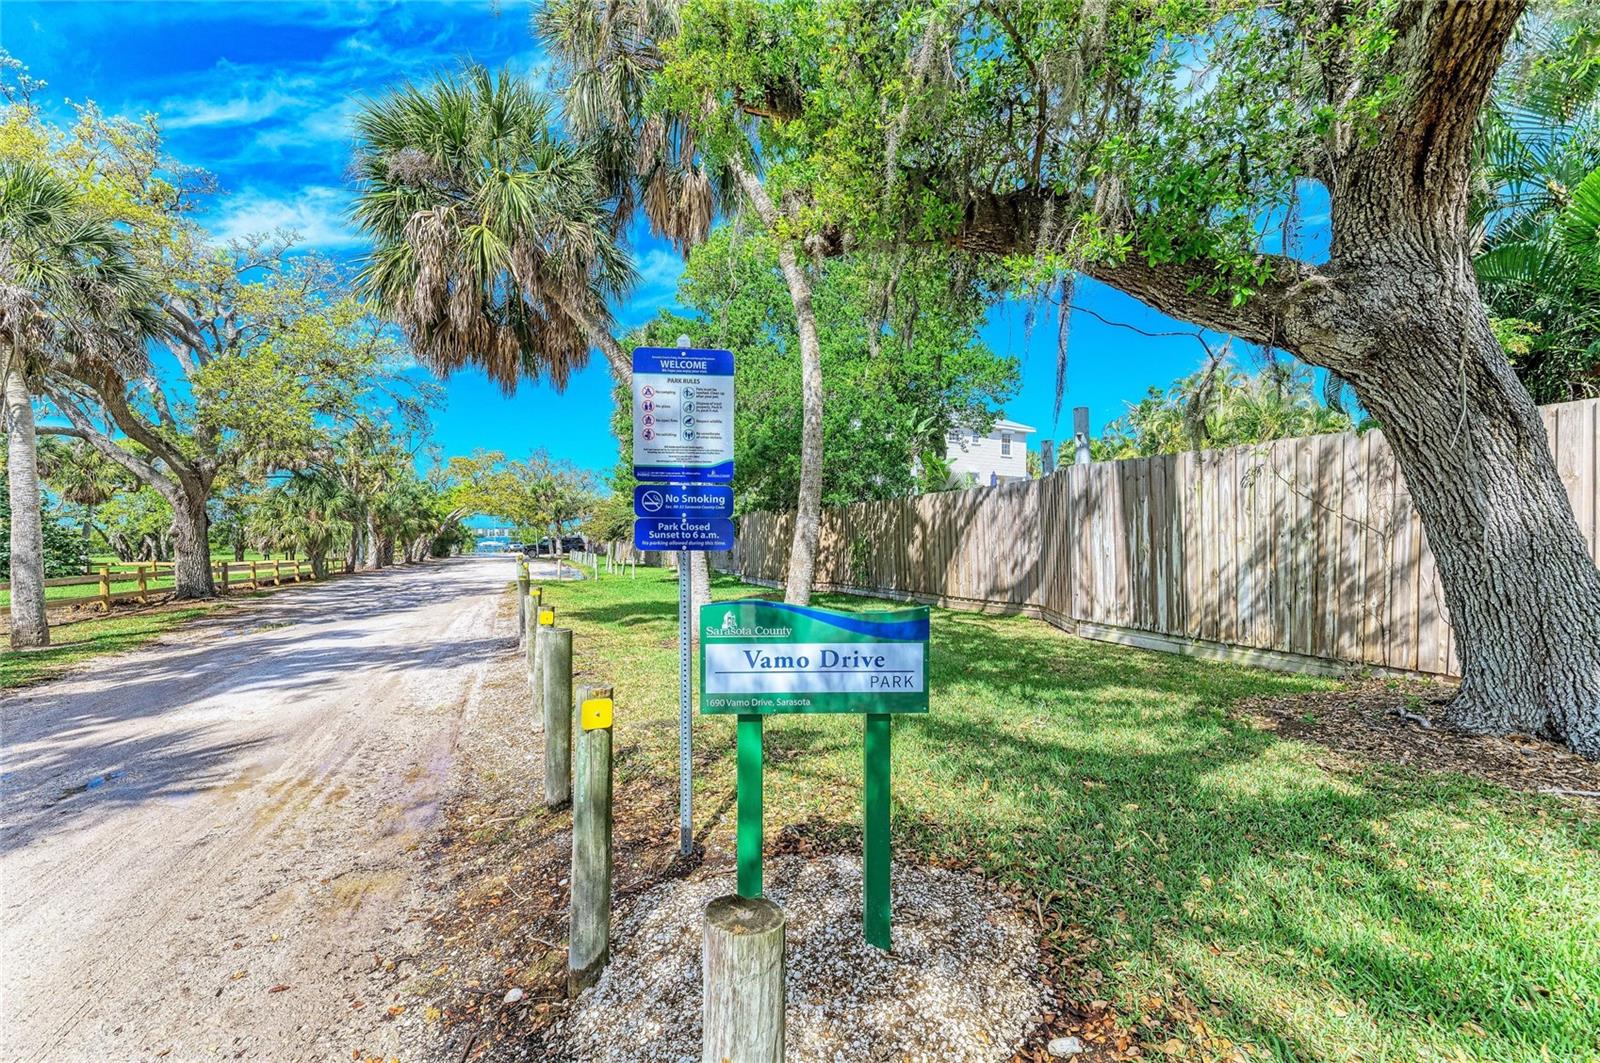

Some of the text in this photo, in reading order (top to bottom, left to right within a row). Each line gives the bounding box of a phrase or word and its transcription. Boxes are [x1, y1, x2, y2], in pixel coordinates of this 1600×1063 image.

[660, 360, 707, 369] WELCOME
[665, 494, 725, 506] No Smoking
[658, 522, 710, 531] Park Closed
[649, 531, 679, 539] Sunset
[706, 626, 792, 637] Sarasota County
[743, 649, 885, 669] Vamo Drive
[870, 675, 914, 688] PARK
[706, 698, 811, 707] 1690 Vamo Drive, Sarasota
